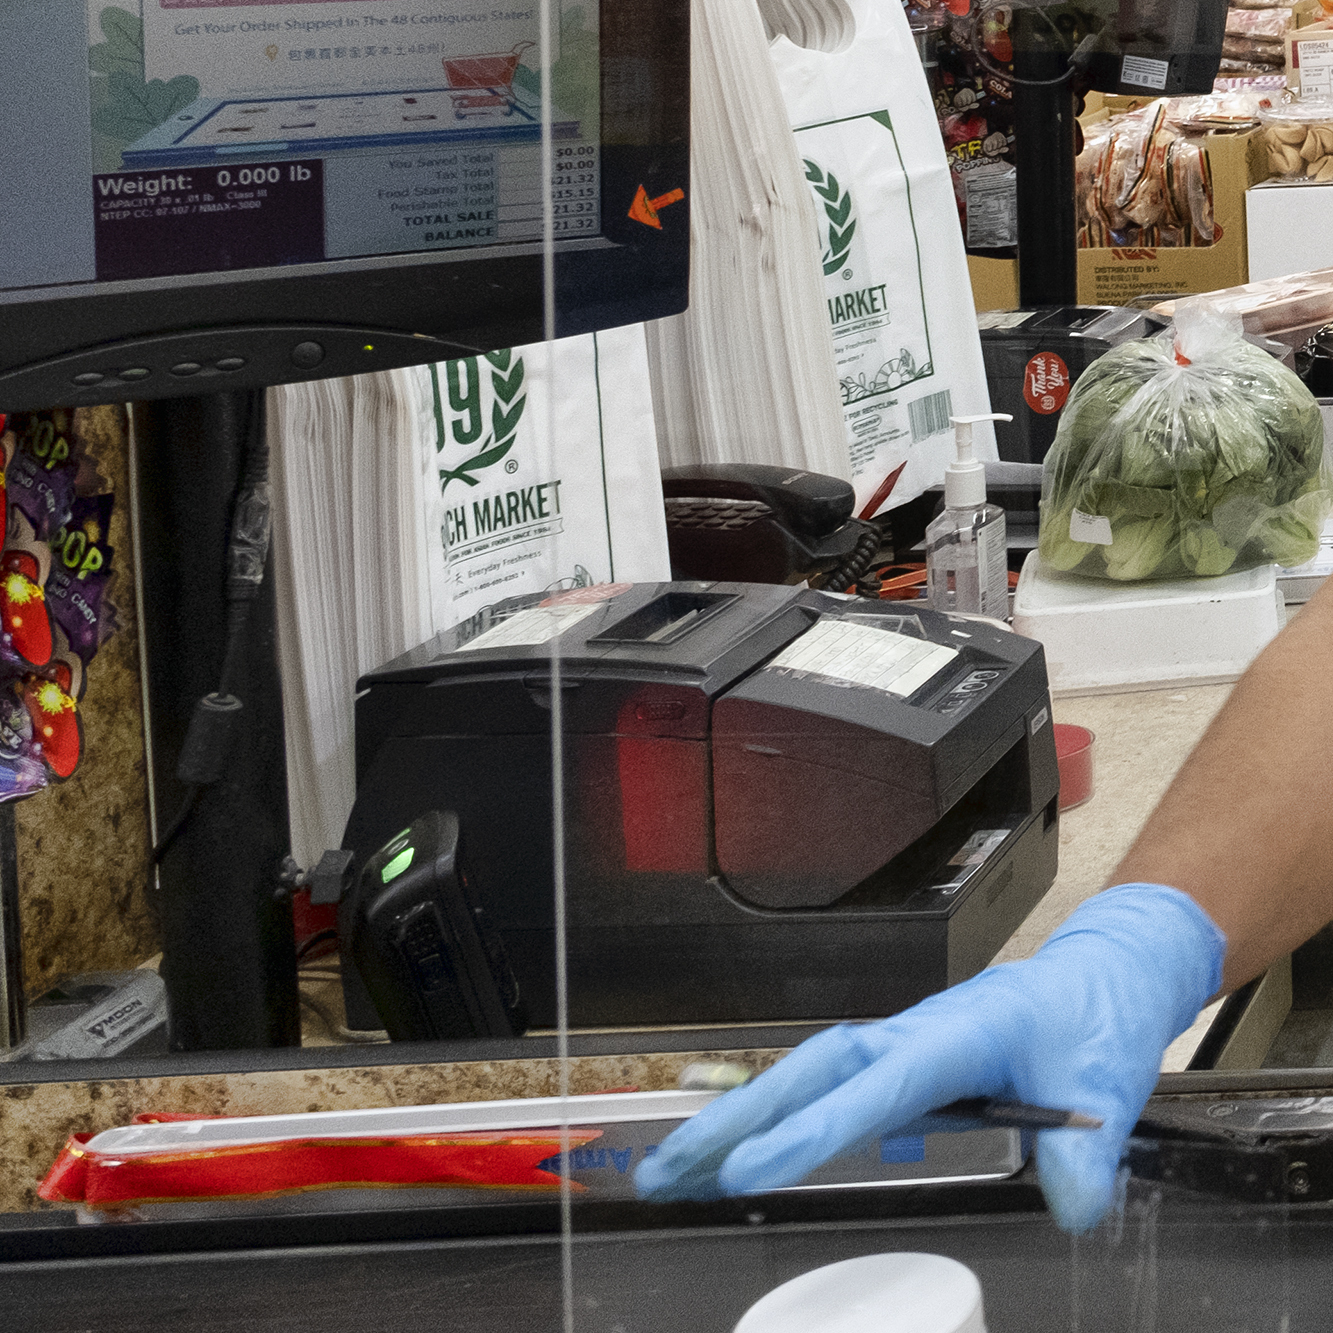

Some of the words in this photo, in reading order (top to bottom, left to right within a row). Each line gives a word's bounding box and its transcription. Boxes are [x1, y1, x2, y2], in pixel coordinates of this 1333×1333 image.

[174, 23, 202, 37] Get
[203, 21, 238, 35] Your
[240, 19, 281, 34] Order
[284, 16, 345, 33] Shipped
[362, 15, 388, 28] The
[390, 13, 409, 26] 48
[410, 11, 490, 28] Contiguous
[988, 78, 1014, 100] COLA
[462, 152, 495, 164] Total
[556, 145, 595, 158] $0.00
[462, 167, 495, 179] Total
[556, 159, 595, 173] $0.00
[97, 175, 193, 197] Weight:
[216, 166, 281, 188] 0.000
[289, 164, 312, 182] lb
[462, 181, 495, 193] Total
[546, 202, 595, 215] 21.32
[402, 214, 453, 228] TOTAL
[456, 210, 495, 223] SALE
[546, 218, 595, 232] 21.32
[424, 227, 496, 243] BALANCE
[1031, 356, 1047, 398] Thank
[472, 479, 562, 538] MARKET
[467, 561, 502, 580] Everyday
[502, 550, 542, 568] Freshness
